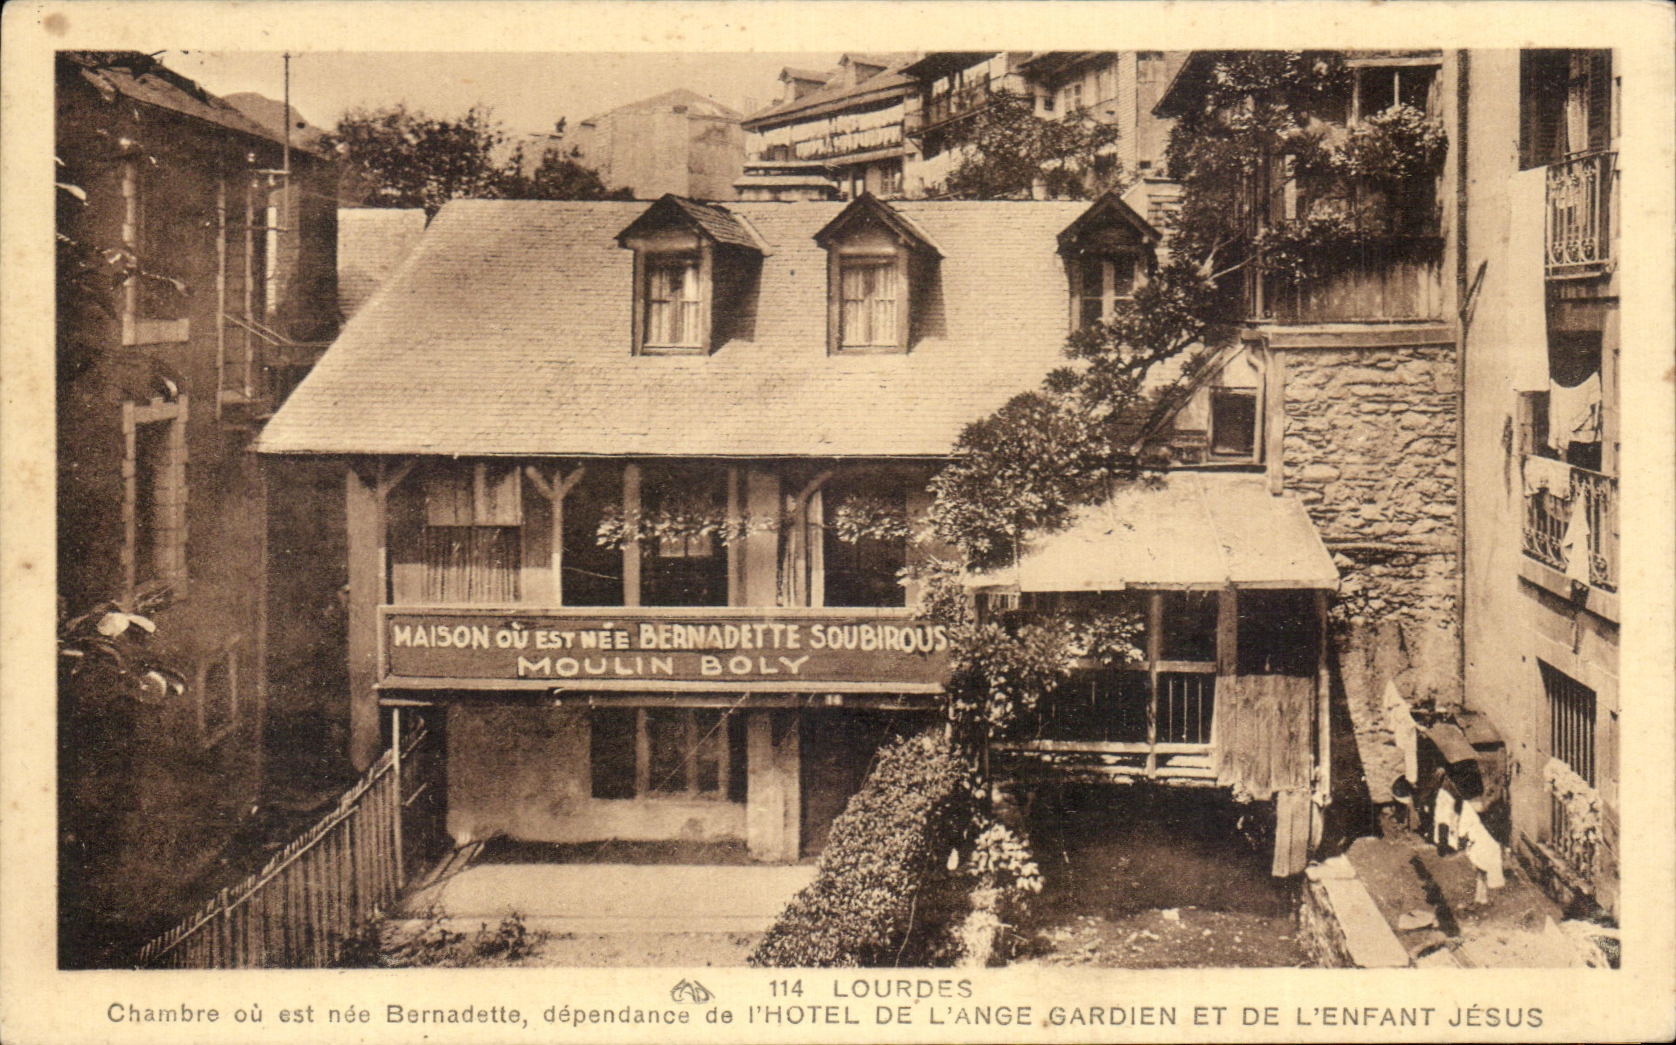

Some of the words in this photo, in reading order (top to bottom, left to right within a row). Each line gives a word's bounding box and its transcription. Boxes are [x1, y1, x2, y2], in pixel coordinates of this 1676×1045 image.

[394, 625, 490, 649] MAISON
[496, 621, 529, 649] OÙ
[535, 631, 576, 649] EST
[580, 622, 630, 649] NÉE
[639, 623, 800, 649] BERNADETTE
[809, 624, 948, 653] SOUBIROUS
[517, 656, 674, 676] MOULIN
[701, 655, 809, 675] BOLY
